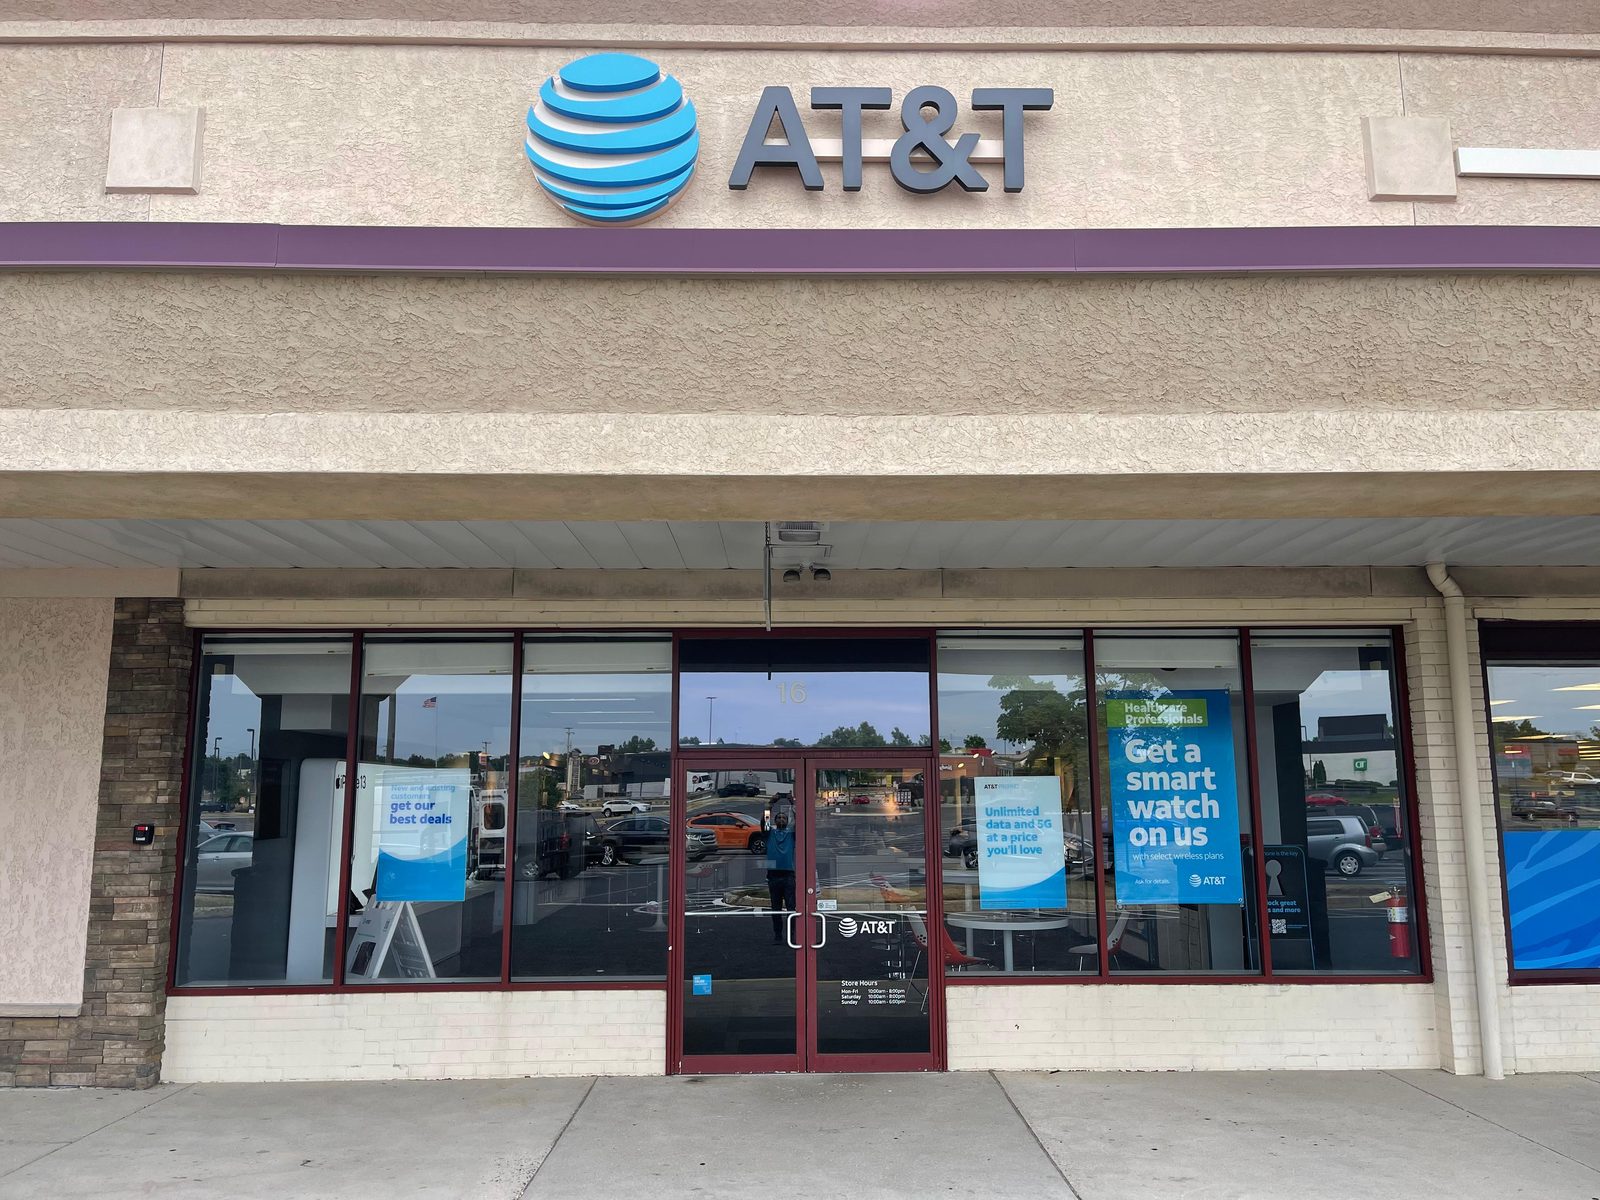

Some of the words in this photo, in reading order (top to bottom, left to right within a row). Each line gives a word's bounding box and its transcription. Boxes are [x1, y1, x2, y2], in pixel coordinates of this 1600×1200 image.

[728, 85, 1054, 194] AT&T
[776, 681, 807, 704] 16
[1124, 702, 1187, 713] Healthcare
[1125, 714, 1203, 725] Professionals
[1125, 739, 1178, 763] Get
[1184, 743, 1201, 763] a
[1126, 767, 1217, 791] smart
[391, 801, 411, 813] get
[415, 803, 435, 811] our
[985, 806, 1039, 817] Unlimited
[1127, 793, 1219, 819] watch
[389, 814, 417, 824] best
[420, 814, 452, 824] deals
[986, 819, 1011, 829] data
[1014, 819, 1035, 829] and
[1038, 819, 1052, 829] 5G
[987, 833, 998, 842] at
[1001, 834, 1007, 842] a
[1010, 832, 1038, 844] price
[1129, 826, 1167, 847] on
[1174, 826, 1208, 847] us
[987, 845, 1017, 857] you'll
[1020, 845, 1042, 855] love
[1132, 853, 1149, 861] with
[1204, 853, 1224, 861] plans
[1203, 876, 1226, 885] AT&T
[860, 921, 895, 934] AT&T
